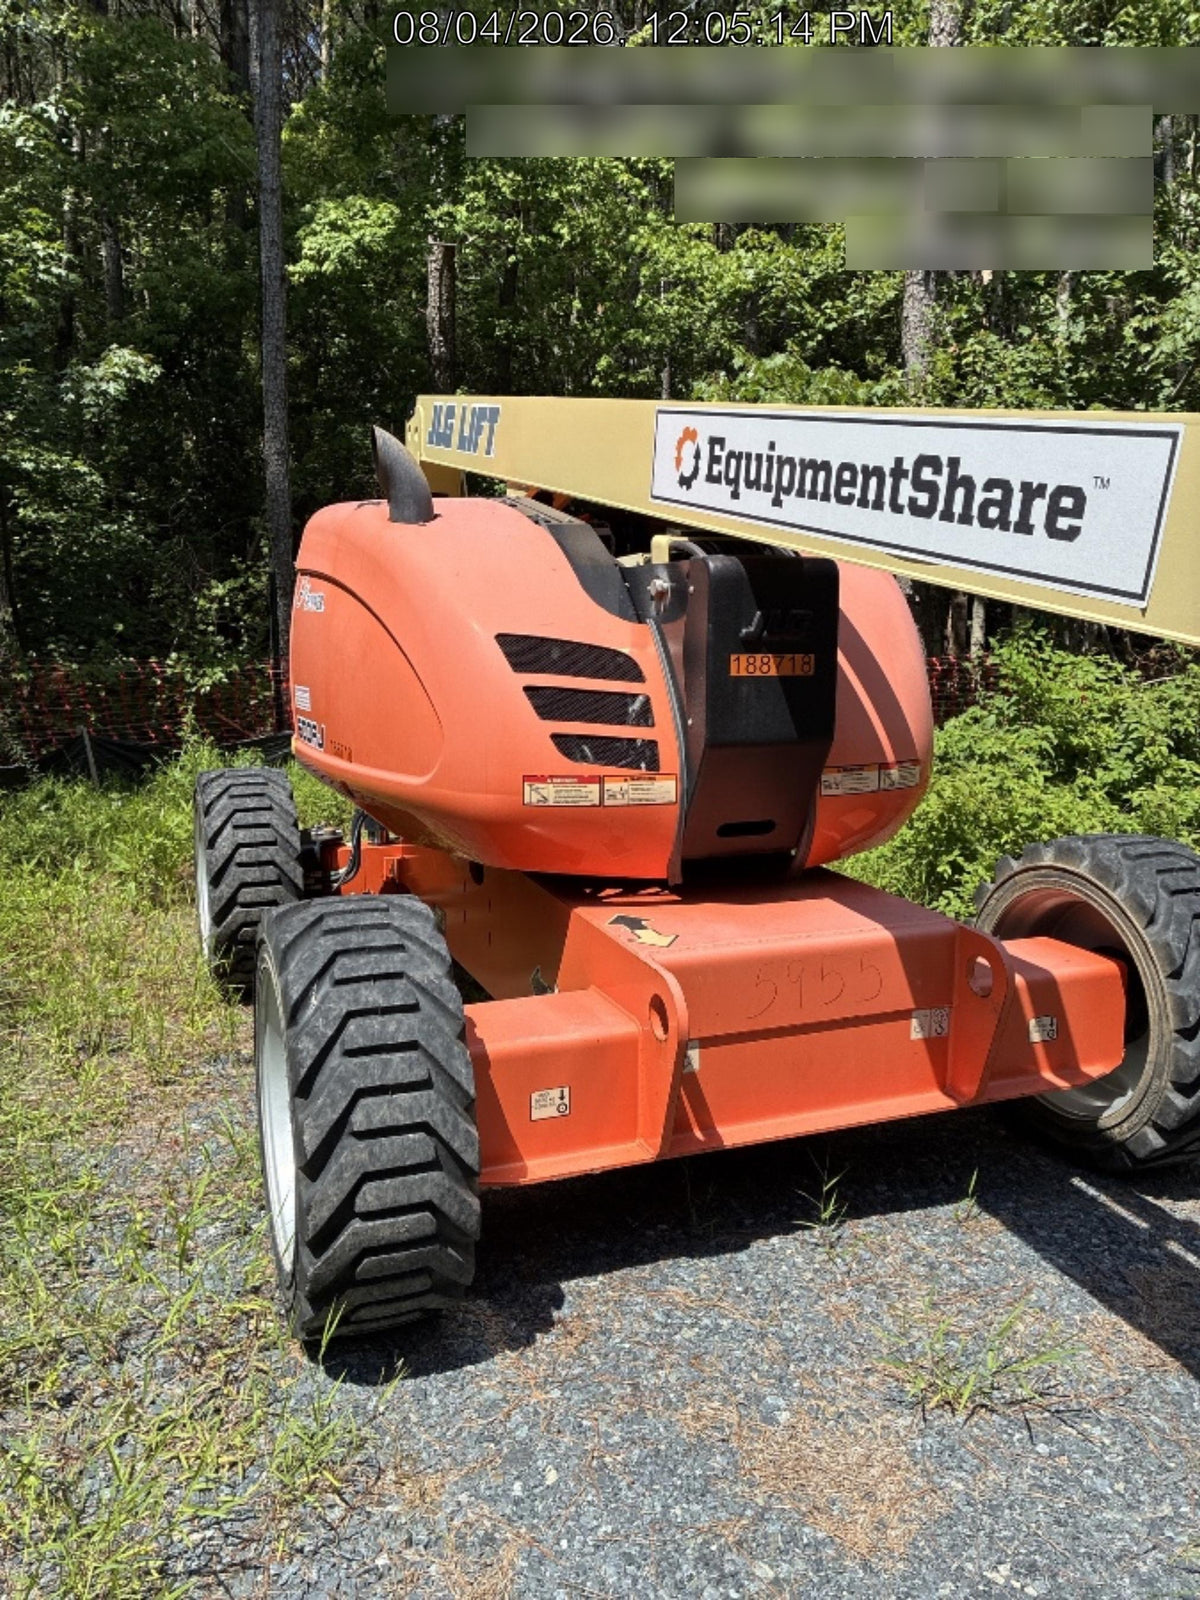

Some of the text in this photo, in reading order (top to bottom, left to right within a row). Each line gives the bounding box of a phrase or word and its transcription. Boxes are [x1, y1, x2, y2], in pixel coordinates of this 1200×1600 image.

[426, 402, 501, 457] JLG LIFT
[705, 434, 1088, 543] EquipmentShare
[731, 654, 813, 675] 188718
[747, 951, 883, 1020] 5955
